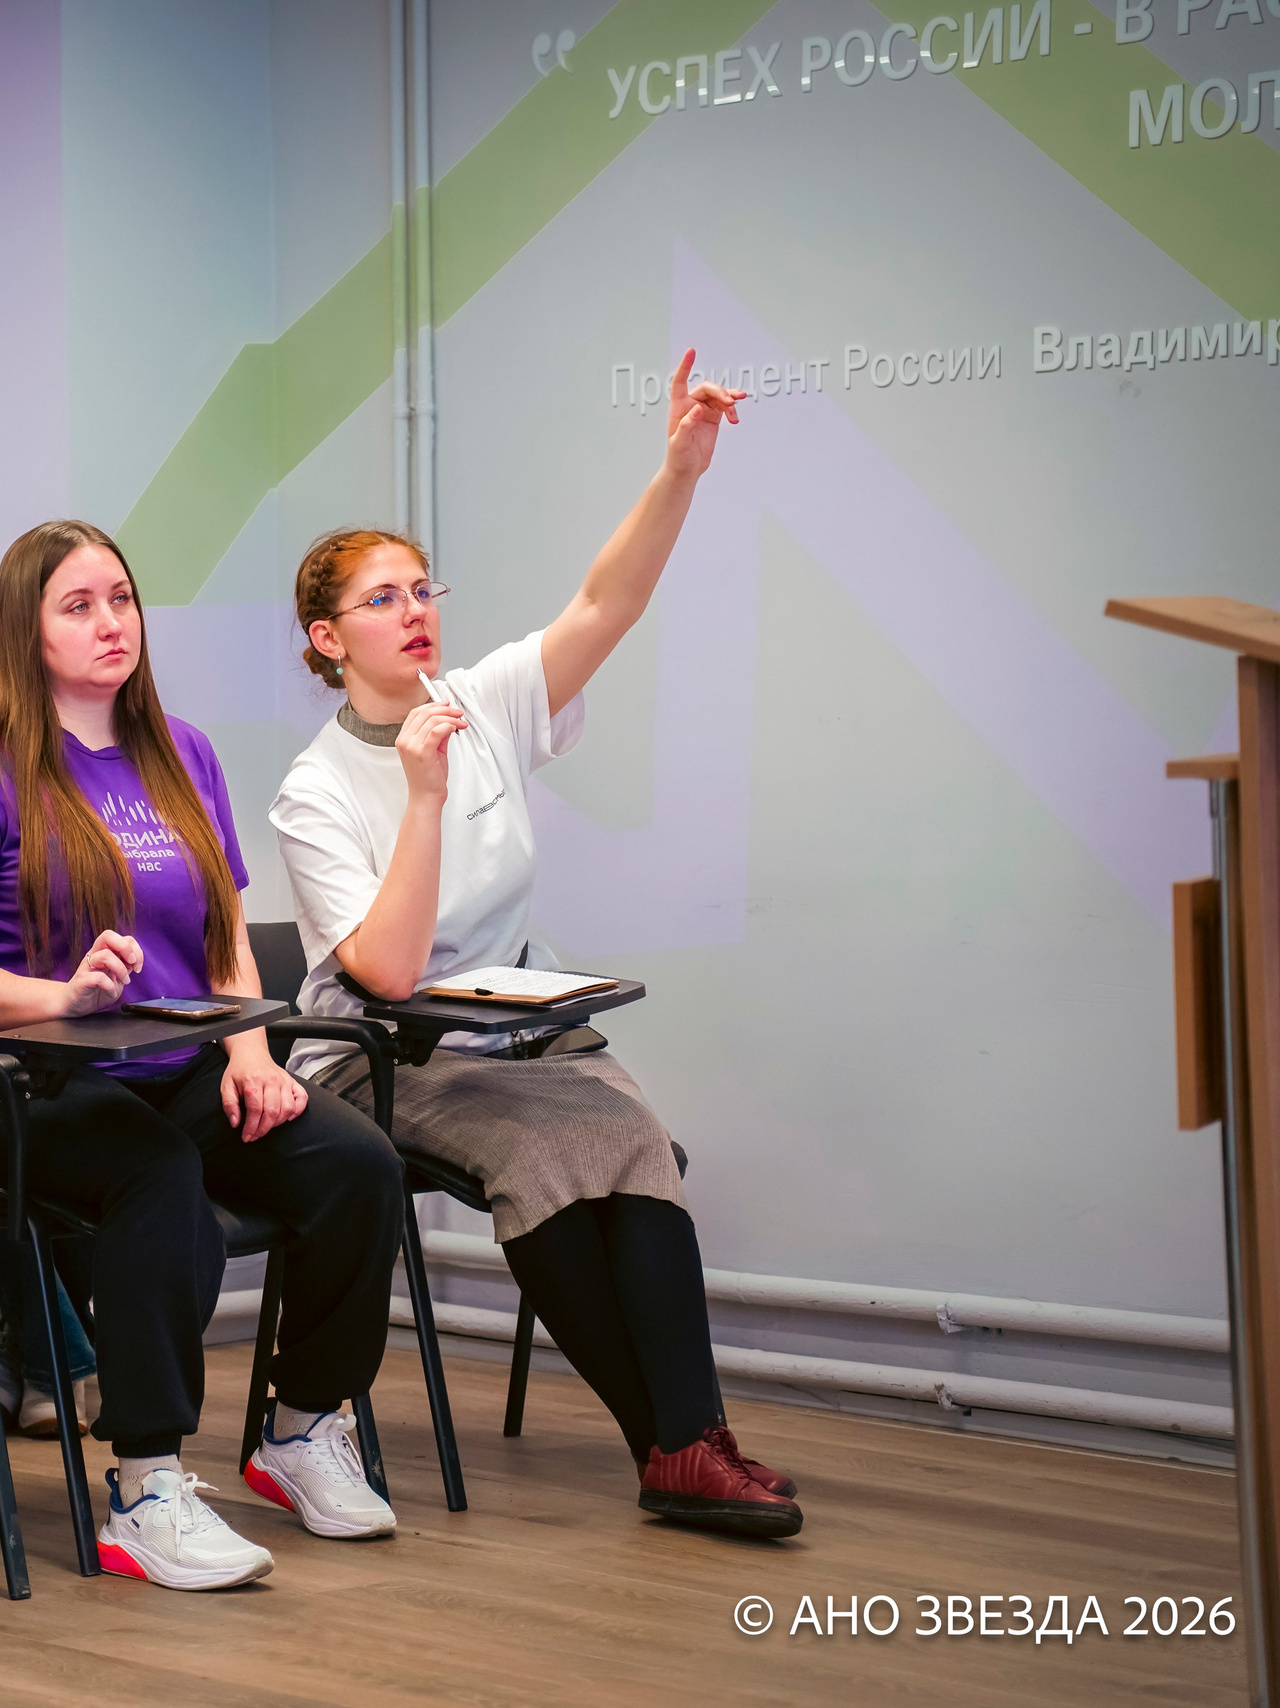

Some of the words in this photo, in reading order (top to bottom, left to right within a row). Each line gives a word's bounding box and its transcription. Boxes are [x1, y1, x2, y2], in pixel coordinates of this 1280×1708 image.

[607, 42, 782, 119] УСПЕХ
[801, 0, 1052, 93] РОССИИ
[1116, 0, 1154, 45] В
[843, 343, 1003, 390] России
[123, 849, 176, 861] ыбрала
[137, 861, 162, 872] нас
